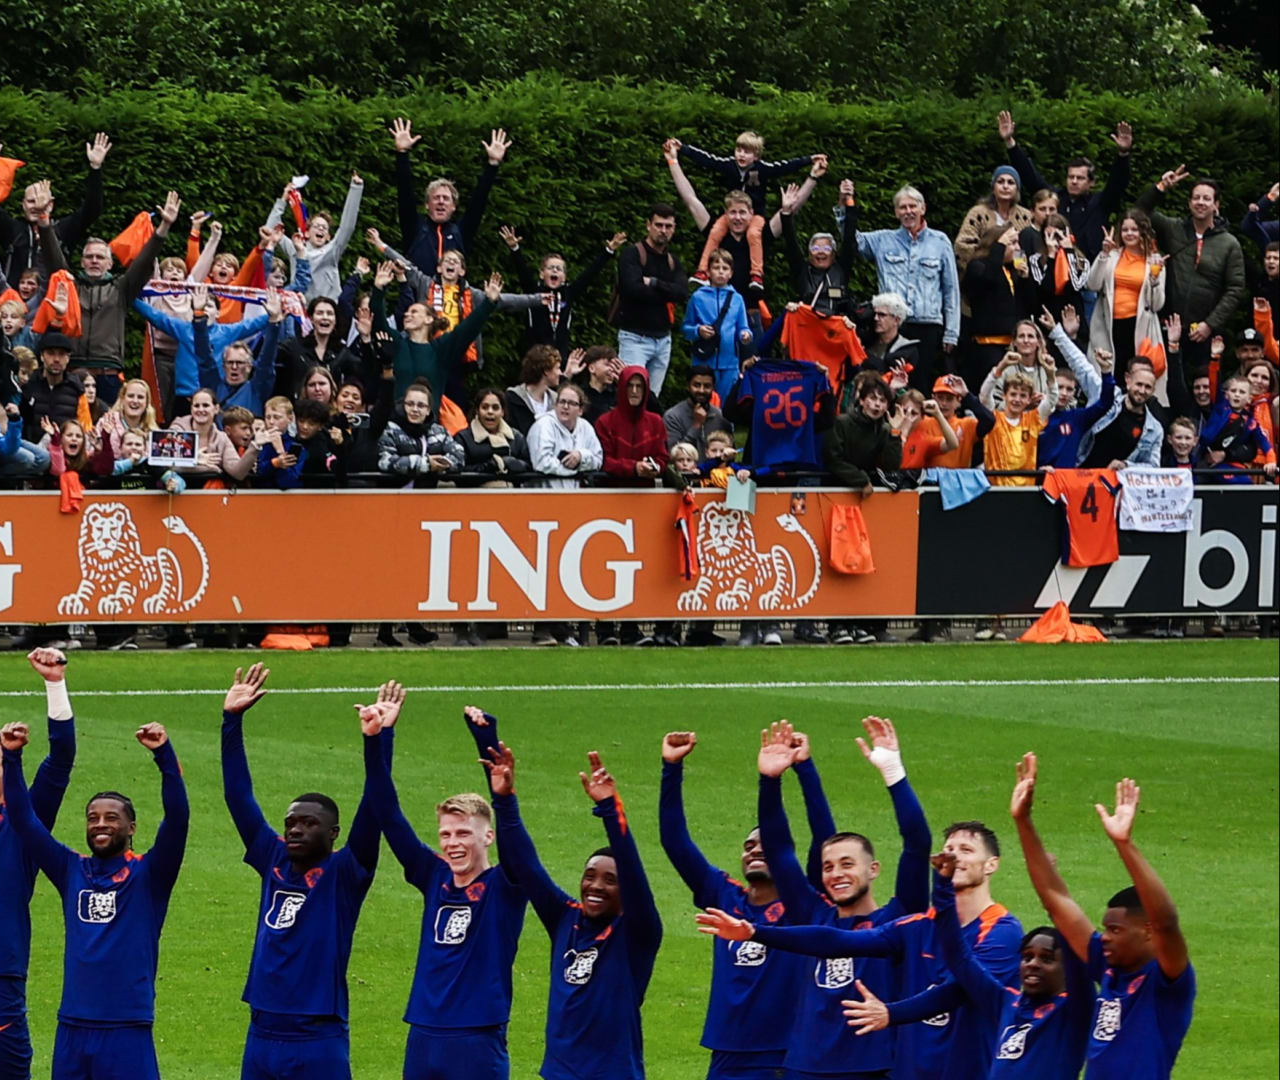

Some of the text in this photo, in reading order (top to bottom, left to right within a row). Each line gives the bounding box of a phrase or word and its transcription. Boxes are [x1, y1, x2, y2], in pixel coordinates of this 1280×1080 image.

[763, 386, 807, 429] 26
[1080, 482, 1099, 523] 4
[416, 518, 643, 614] ING
